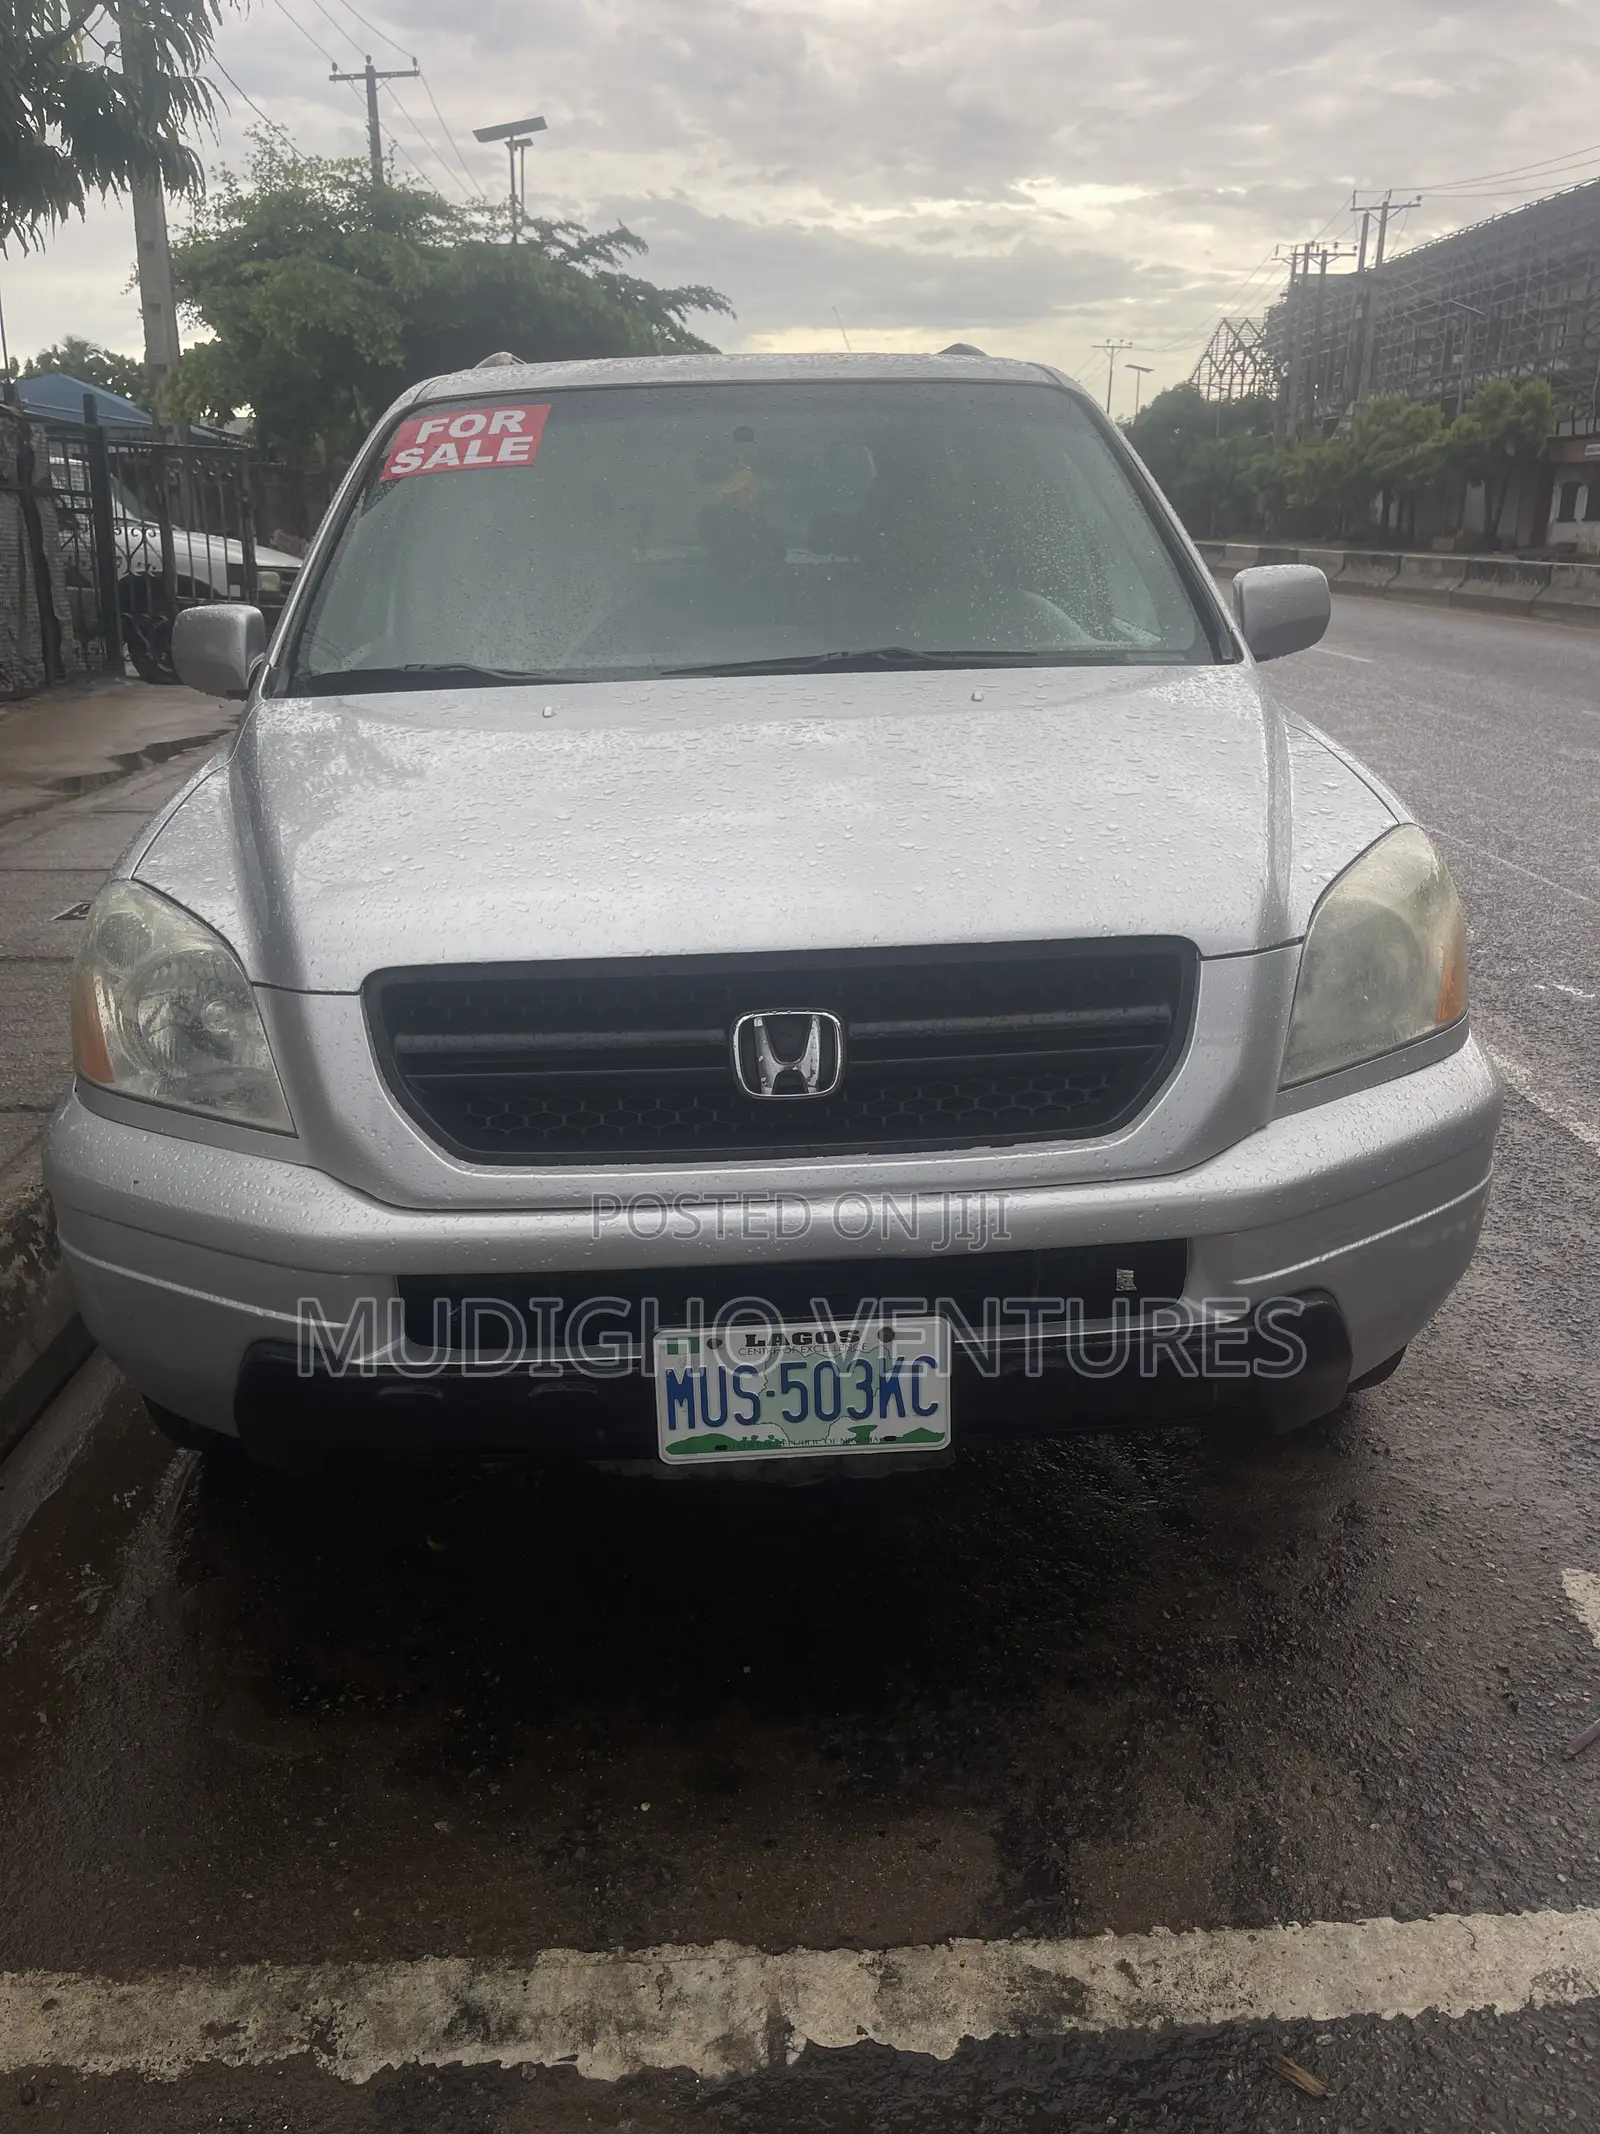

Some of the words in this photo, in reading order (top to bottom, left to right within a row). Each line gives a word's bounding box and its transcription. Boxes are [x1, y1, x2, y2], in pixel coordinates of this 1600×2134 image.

[415, 410, 526, 444] FOR
[391, 436, 533, 474] SALE
[738, 1347, 780, 1356] CENTRE
[745, 1329, 861, 1348] LAGOS
